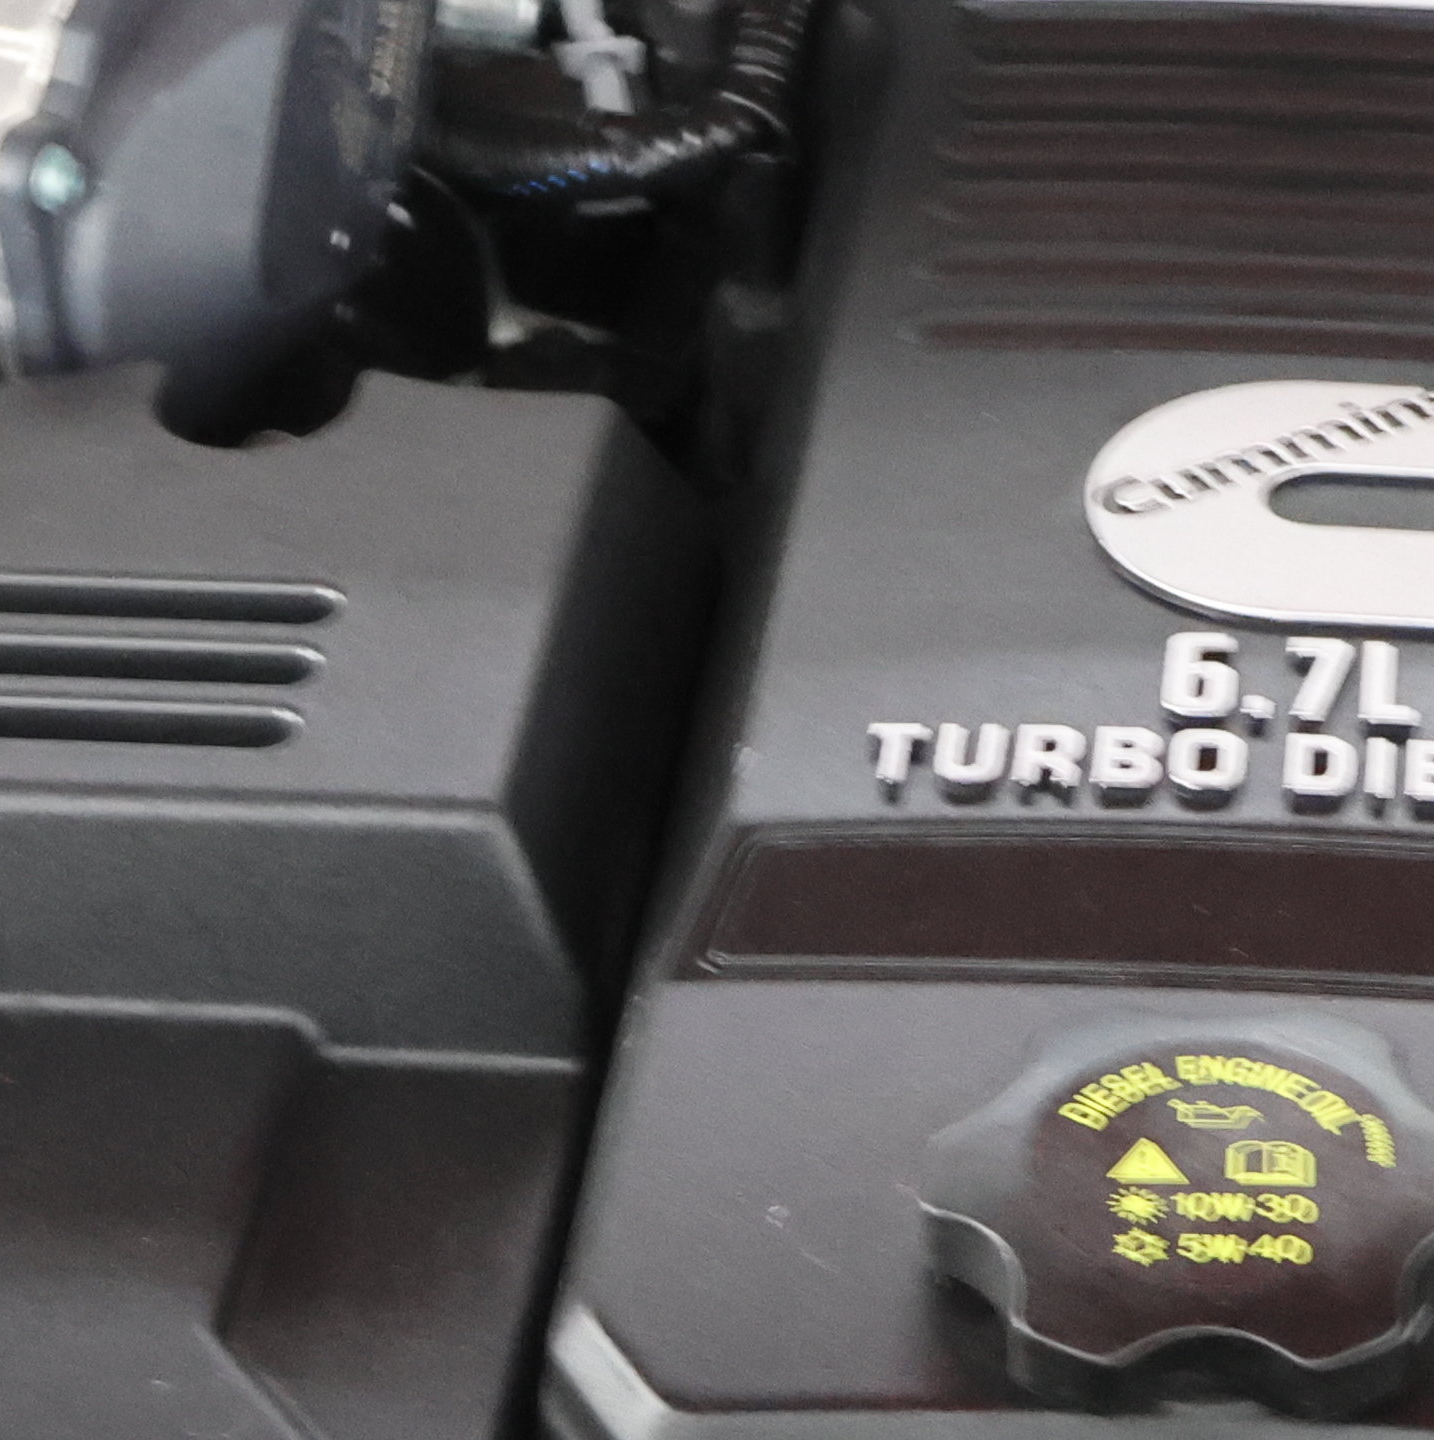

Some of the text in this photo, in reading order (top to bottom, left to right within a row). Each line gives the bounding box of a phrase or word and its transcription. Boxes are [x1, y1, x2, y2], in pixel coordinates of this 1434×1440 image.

[1161, 632, 1420, 725] 6.7L
[869, 723, 1247, 794] TURBO
[1058, 1062, 1183, 1131] DIESEL
[1175, 1055, 1322, 1100] ENGINE
[1175, 1233, 1314, 1264] 5W-40
